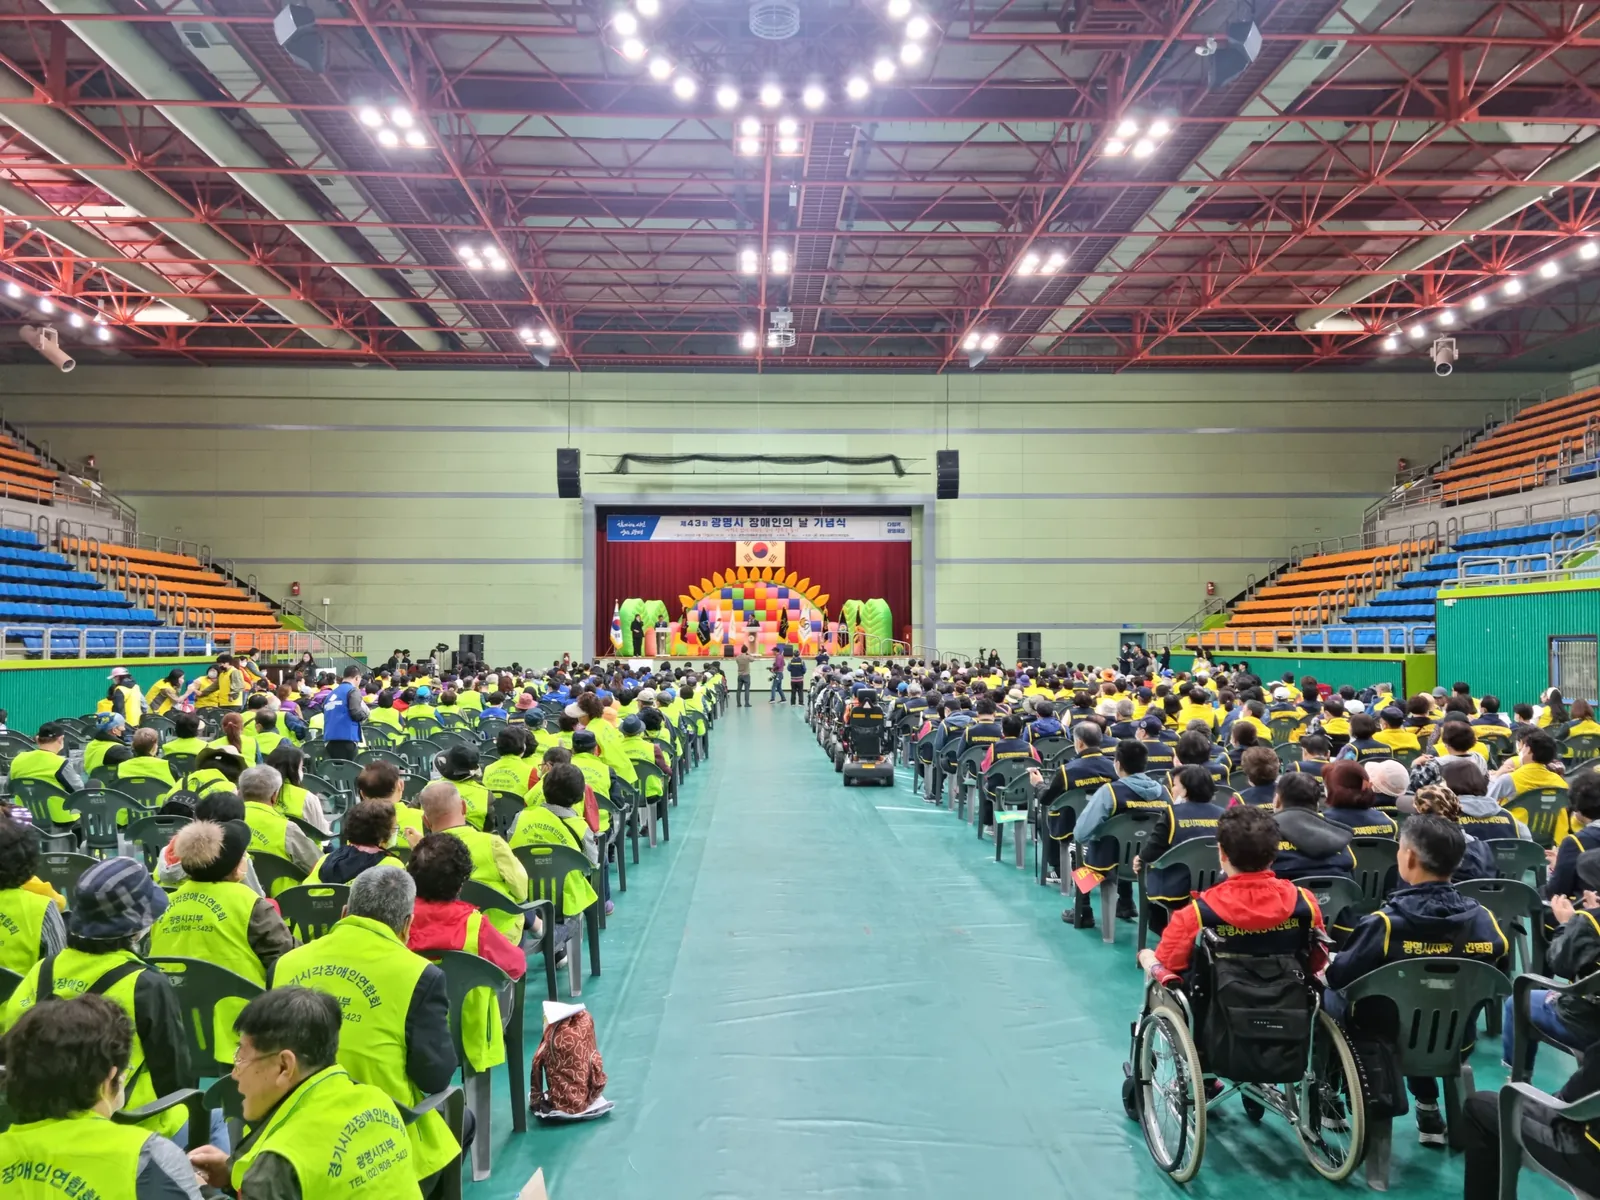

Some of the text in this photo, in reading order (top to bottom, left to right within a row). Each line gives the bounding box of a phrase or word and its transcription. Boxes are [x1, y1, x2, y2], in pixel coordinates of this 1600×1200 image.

[680, 517, 847, 528] 제43회 광명시 장애인의 날 기념식
[356, 1138, 396, 1171] 광명시지부
[348, 1174, 368, 1190] TEL
